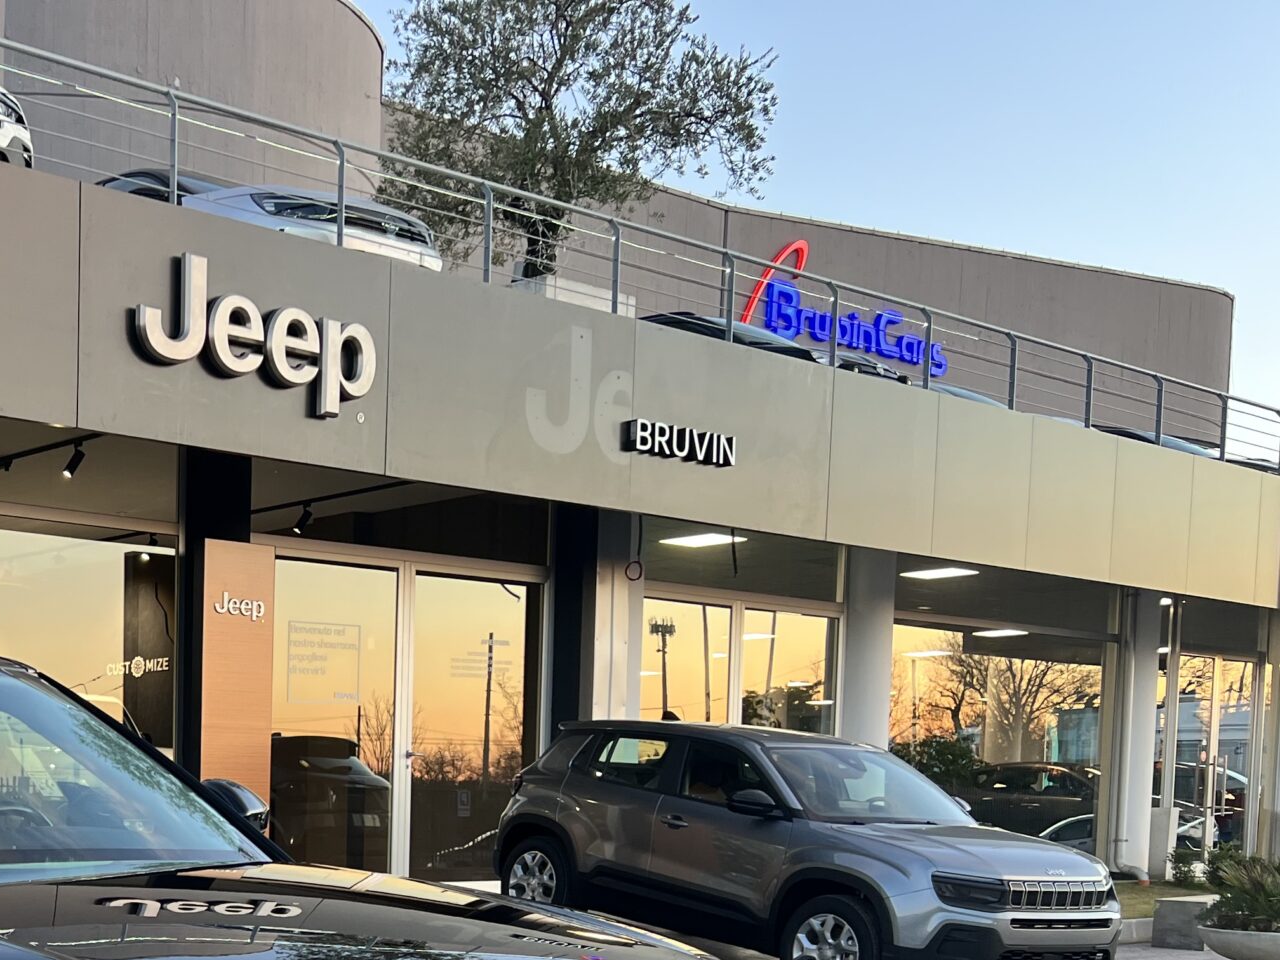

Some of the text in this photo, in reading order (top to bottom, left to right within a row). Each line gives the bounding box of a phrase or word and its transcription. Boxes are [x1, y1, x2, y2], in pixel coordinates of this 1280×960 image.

[132, 250, 378, 420] Jeep
[634, 418, 737, 467] BRUVIN
[214, 592, 265, 621] Jeep
